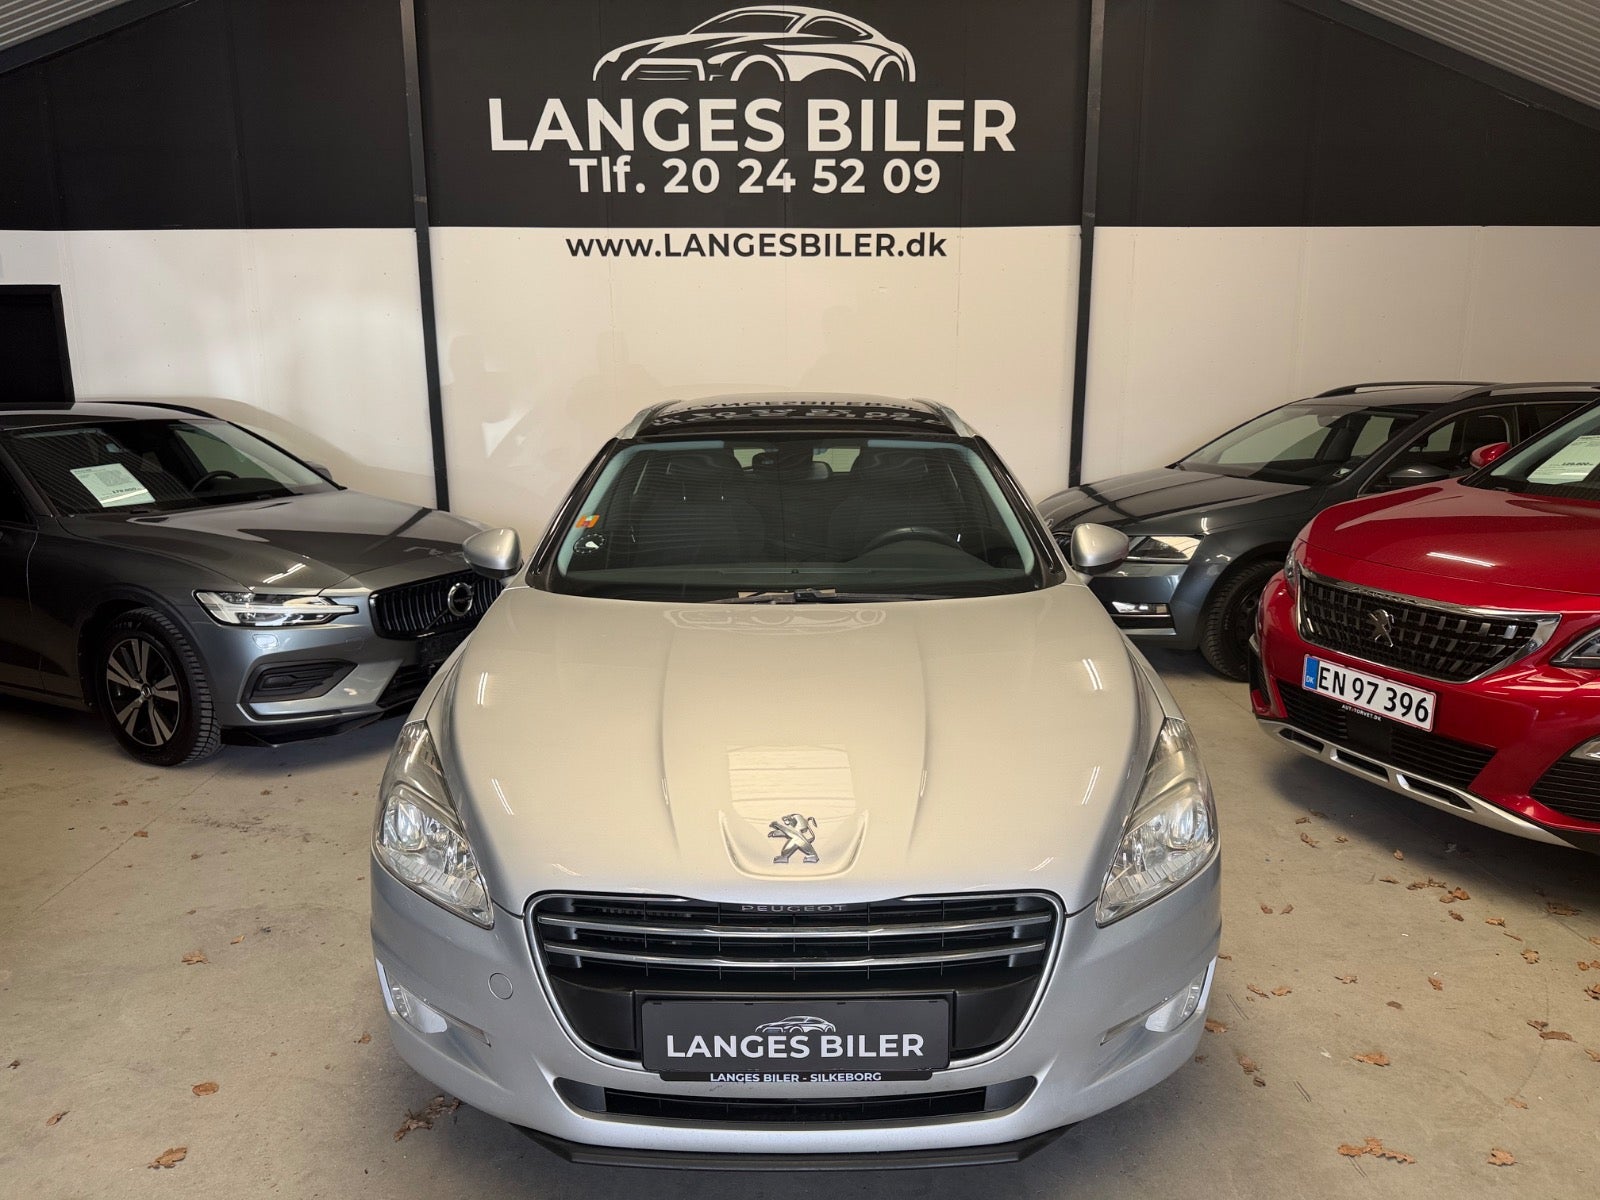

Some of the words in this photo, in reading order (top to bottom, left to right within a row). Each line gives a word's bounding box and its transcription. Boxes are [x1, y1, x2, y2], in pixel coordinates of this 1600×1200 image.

[488, 97, 785, 152] LANGES
[807, 98, 1017, 152] BILER
[569, 155, 646, 193] Tlf.
[663, 158, 720, 193] 20
[737, 158, 796, 193] 24
[812, 158, 866, 193] 52
[883, 158, 941, 193] 09
[566, 232, 947, 257] www.LANGESBILER.dk
[1306, 675, 1315, 685] DK
[1318, 666, 1346, 696] EN
[1352, 677, 1379, 705] 97
[1384, 687, 1429, 723] 396
[666, 1034, 810, 1059] LANGES
[820, 1033, 924, 1058] BILER
[710, 1073, 760, 1083] LANGES
[763, 1073, 799, 1083] BILER
[810, 1072, 882, 1083] SILKEBORG
